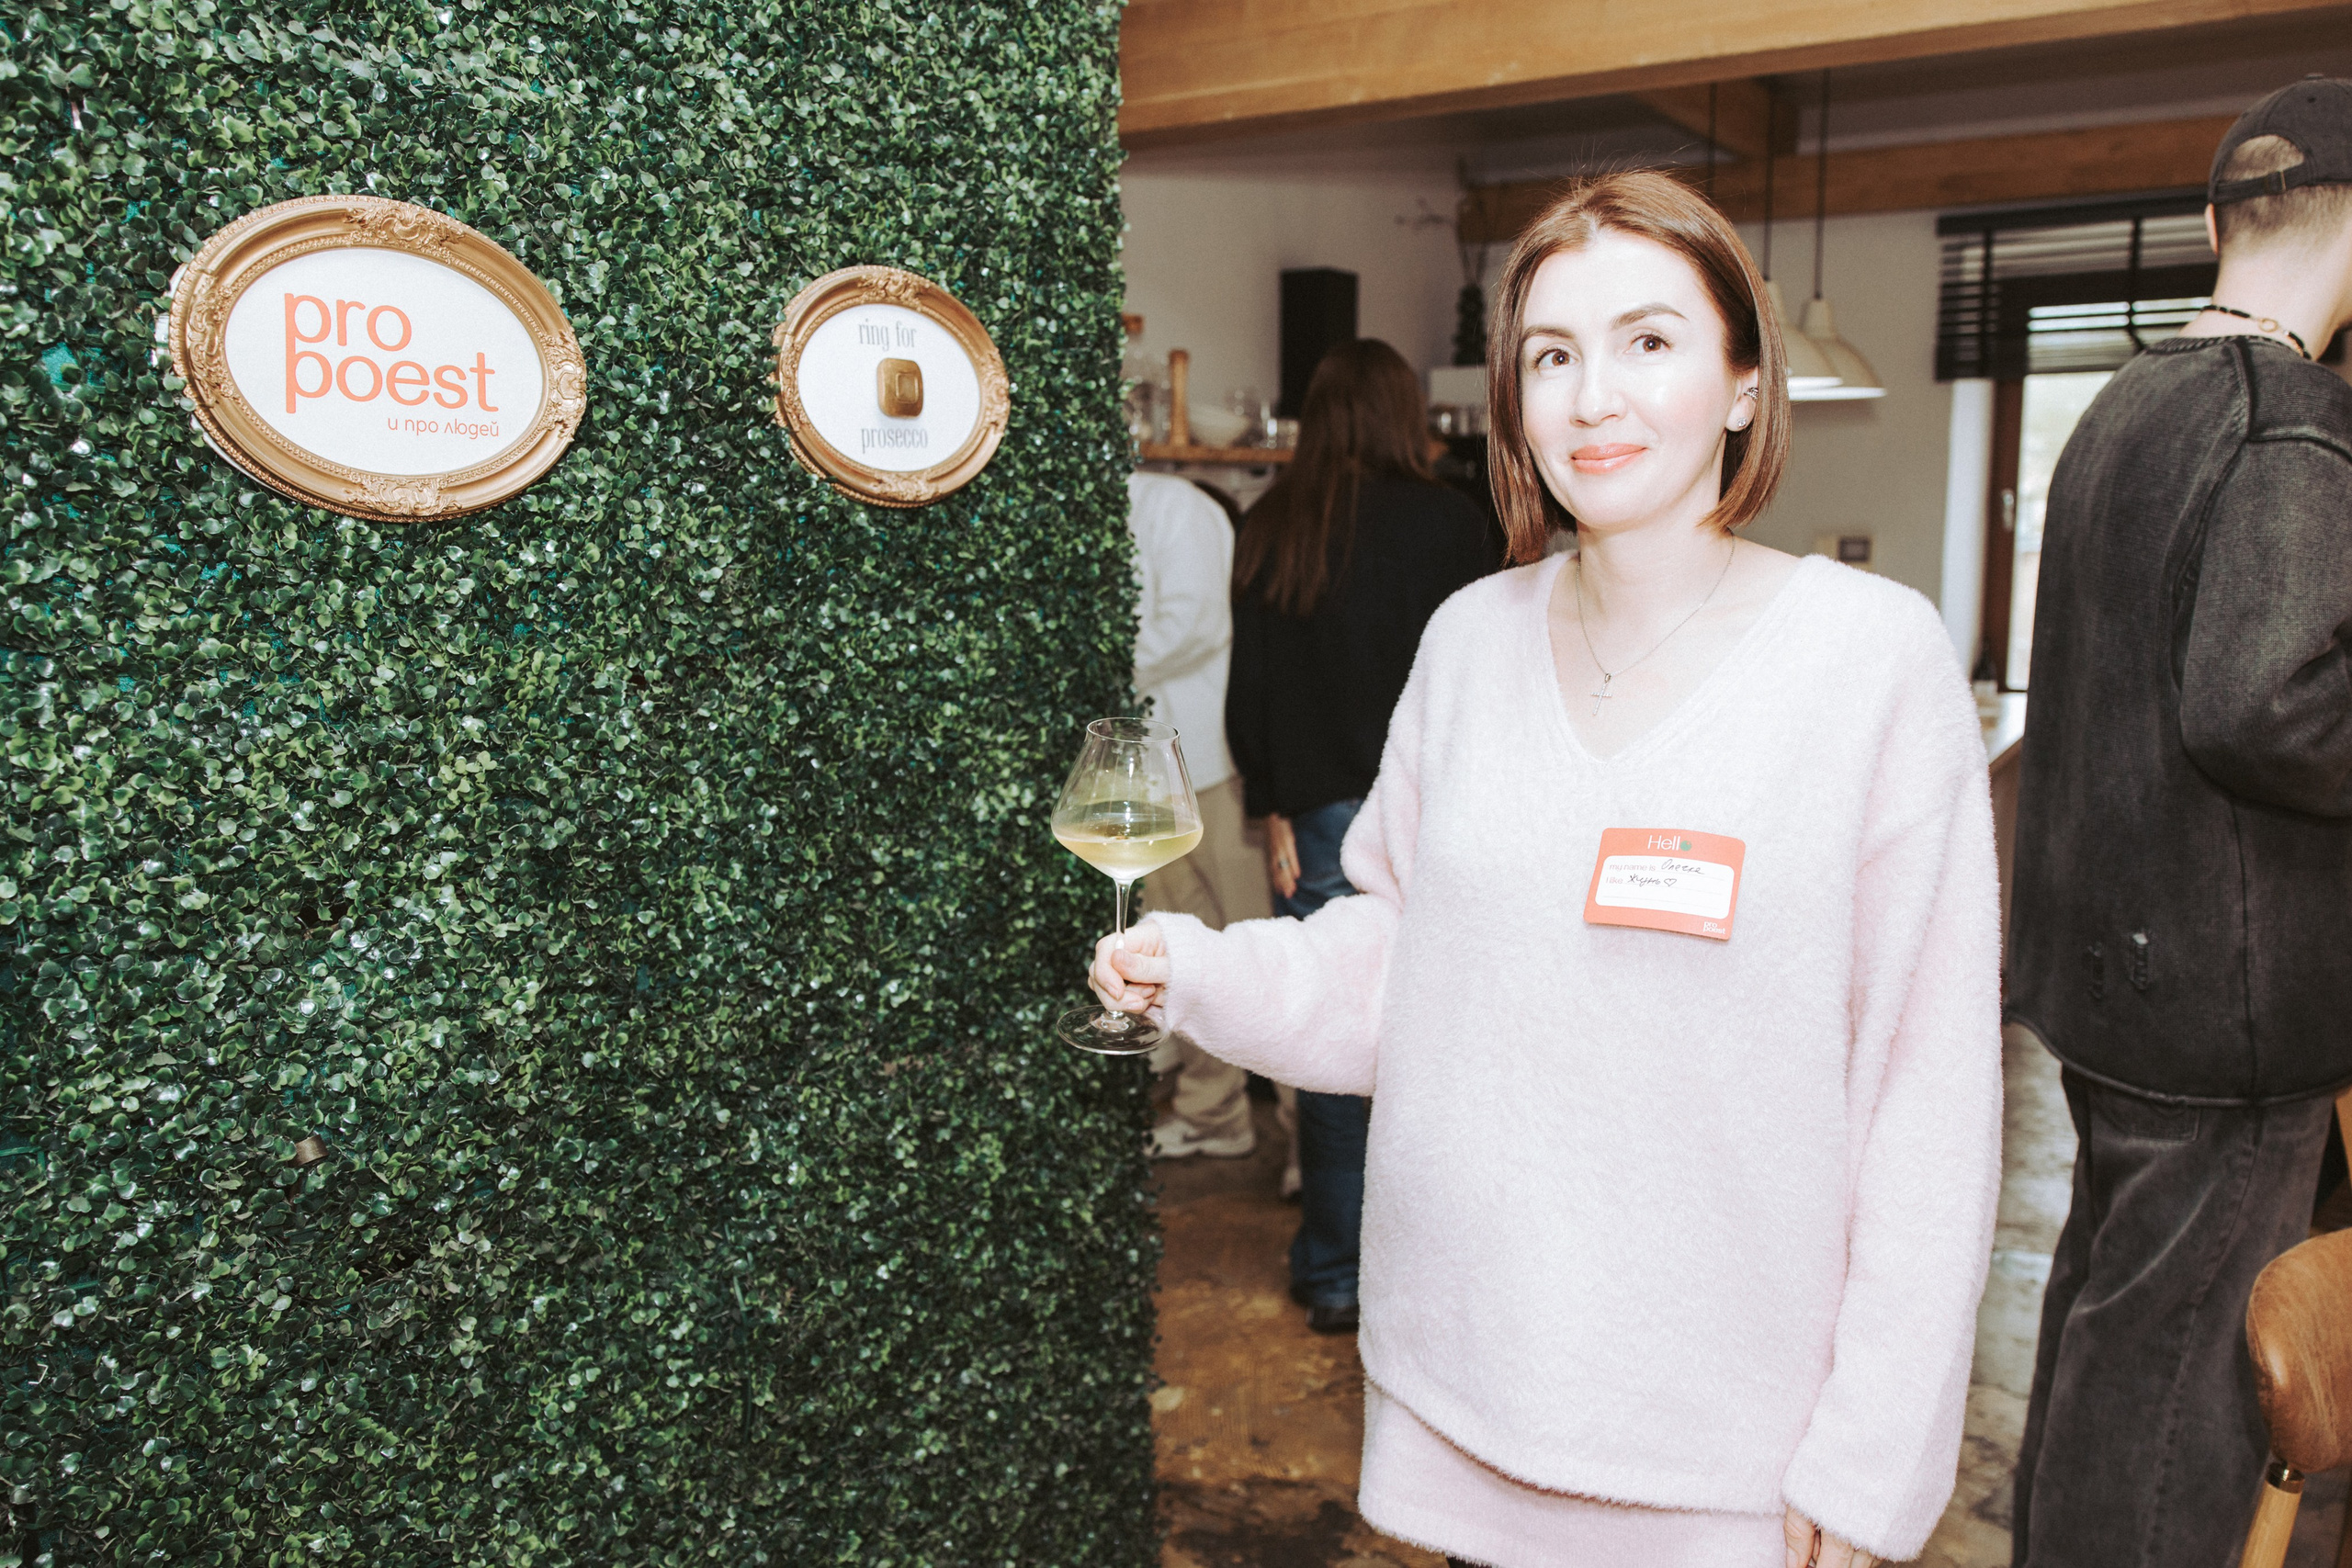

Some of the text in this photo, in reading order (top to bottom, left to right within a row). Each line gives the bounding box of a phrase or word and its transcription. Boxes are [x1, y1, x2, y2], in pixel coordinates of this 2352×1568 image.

[284, 293, 412, 352] pro
[858, 319, 917, 351] ring for
[286, 351, 499, 413] poest
[388, 417, 500, 440] и про людей
[861, 427, 928, 454] prosecco
